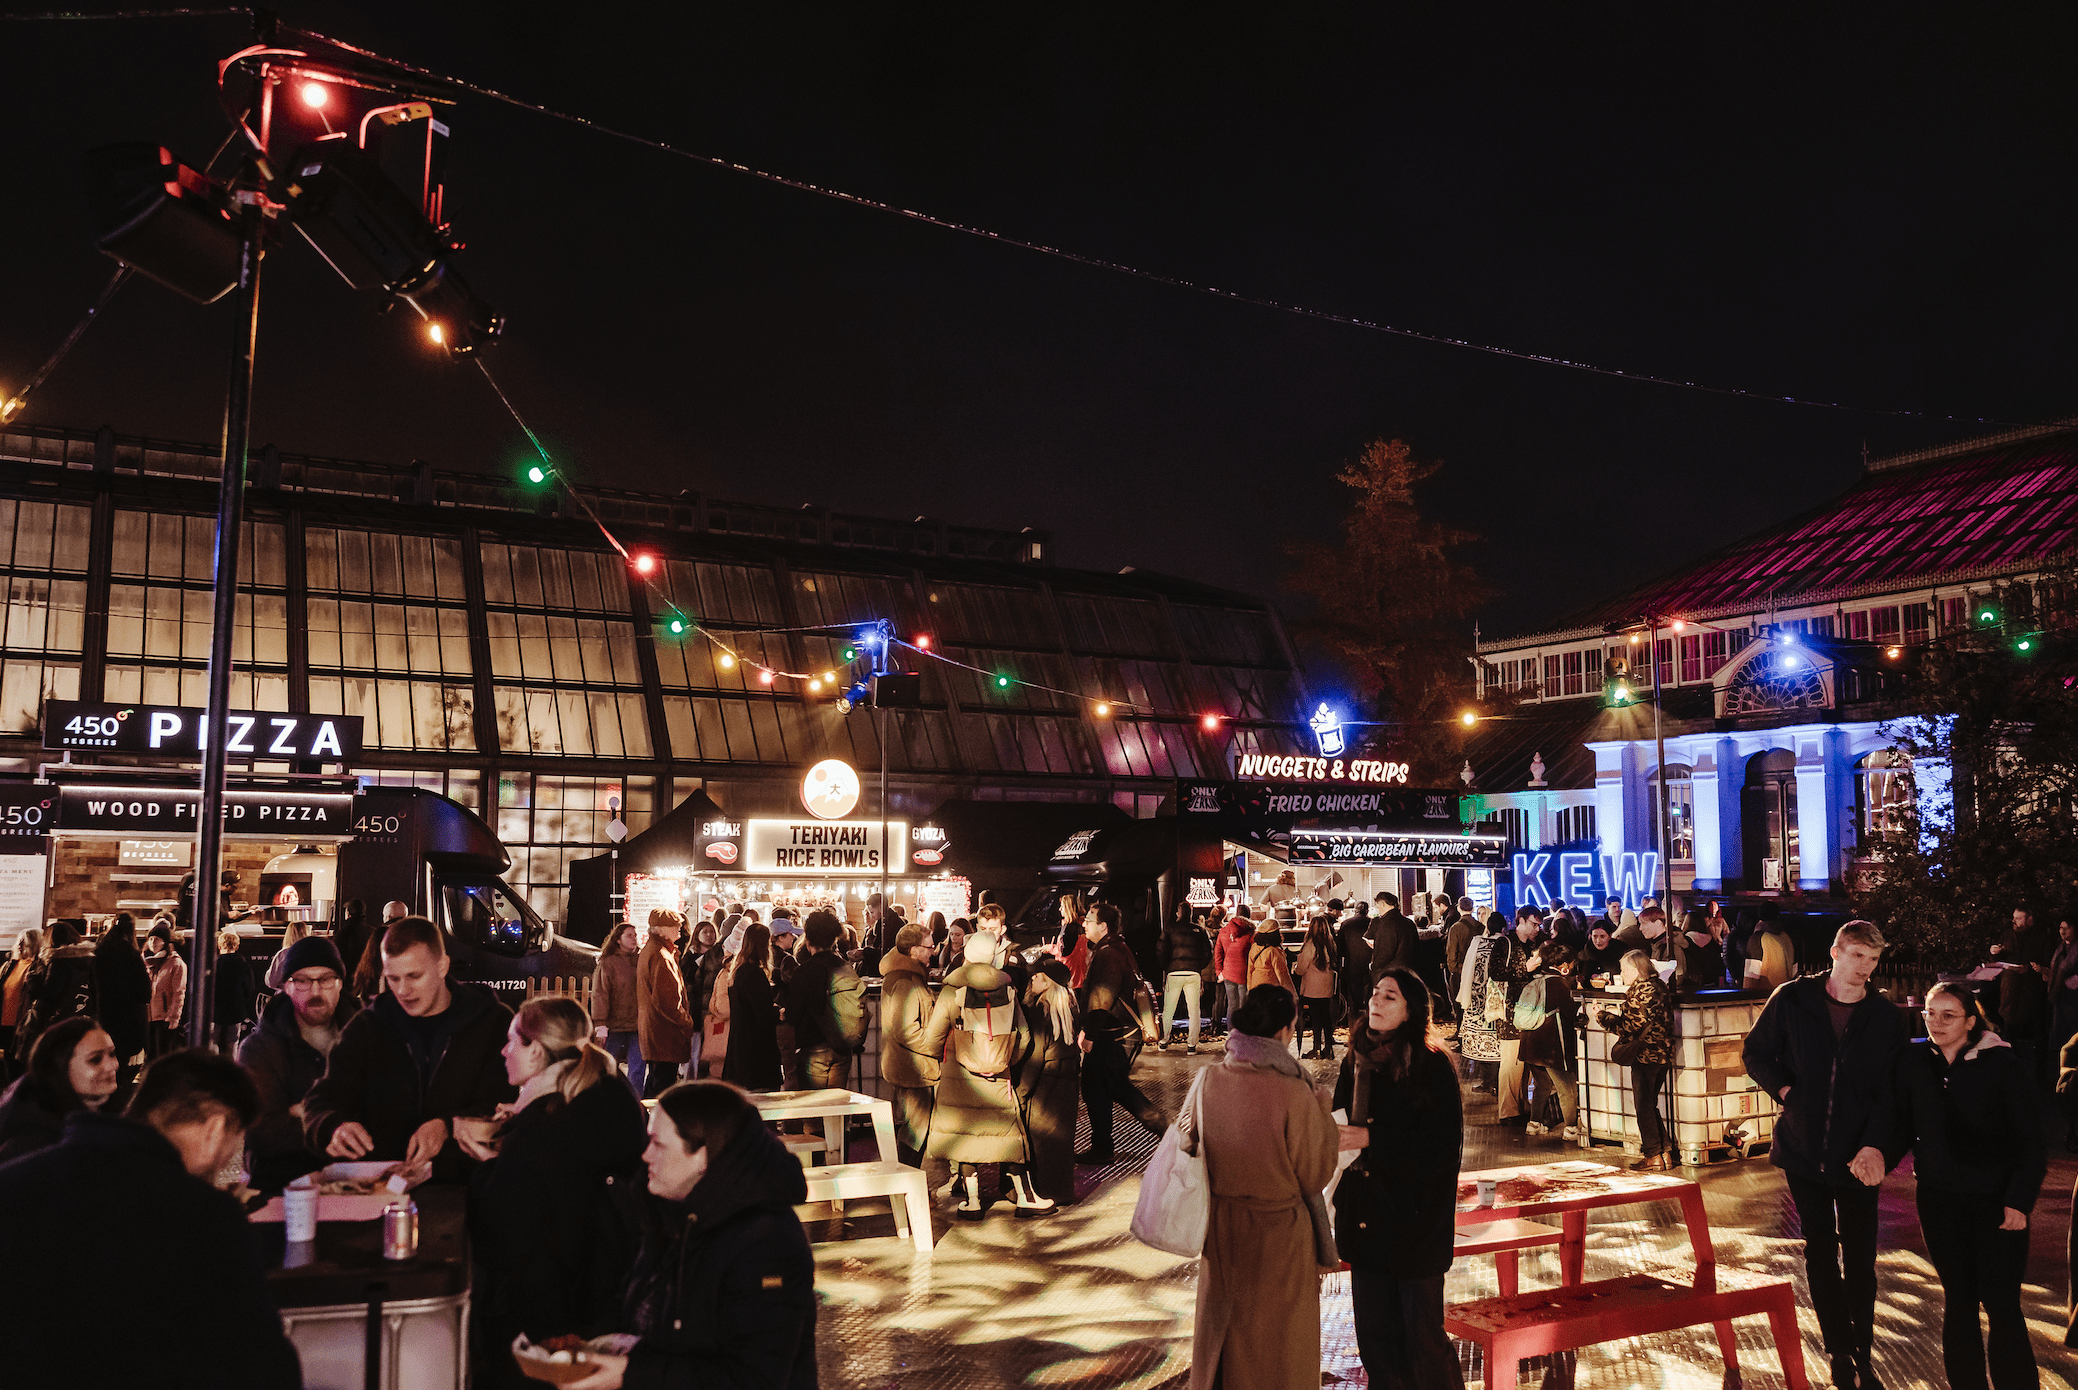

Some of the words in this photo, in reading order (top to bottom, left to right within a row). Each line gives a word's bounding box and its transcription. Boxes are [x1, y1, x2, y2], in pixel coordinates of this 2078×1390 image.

[62, 737, 117, 747] DEGREES
[149, 712, 343, 757] PIZZA
[1238, 754, 1328, 780] NUGGETS
[1330, 759, 1345, 780] &
[1349, 759, 1410, 784] STRIPS
[829, 783, 841, 795] 大
[1190, 786, 1218, 796] ONLY
[1268, 793, 1313, 813] FRIED
[1316, 793, 1381, 812] CHICKEN
[1424, 794, 1448, 804] ONLY
[87, 801, 161, 817] WOOD
[174, 803, 246, 819] FIED
[258, 805, 328, 822] PIZZA
[702, 821, 742, 838] STEAK
[789, 825, 868, 847] TERIYAKI
[776, 848, 816, 868] RICE
[819, 848, 879, 869] BOWLS
[1332, 843, 1352, 858] BIG
[1352, 843, 1416, 858] CARIBBEAN
[1416, 842, 1470, 856] FLAVOURS
[1189, 877, 1216, 888] ONLY
[1513, 852, 1658, 909] KEW
